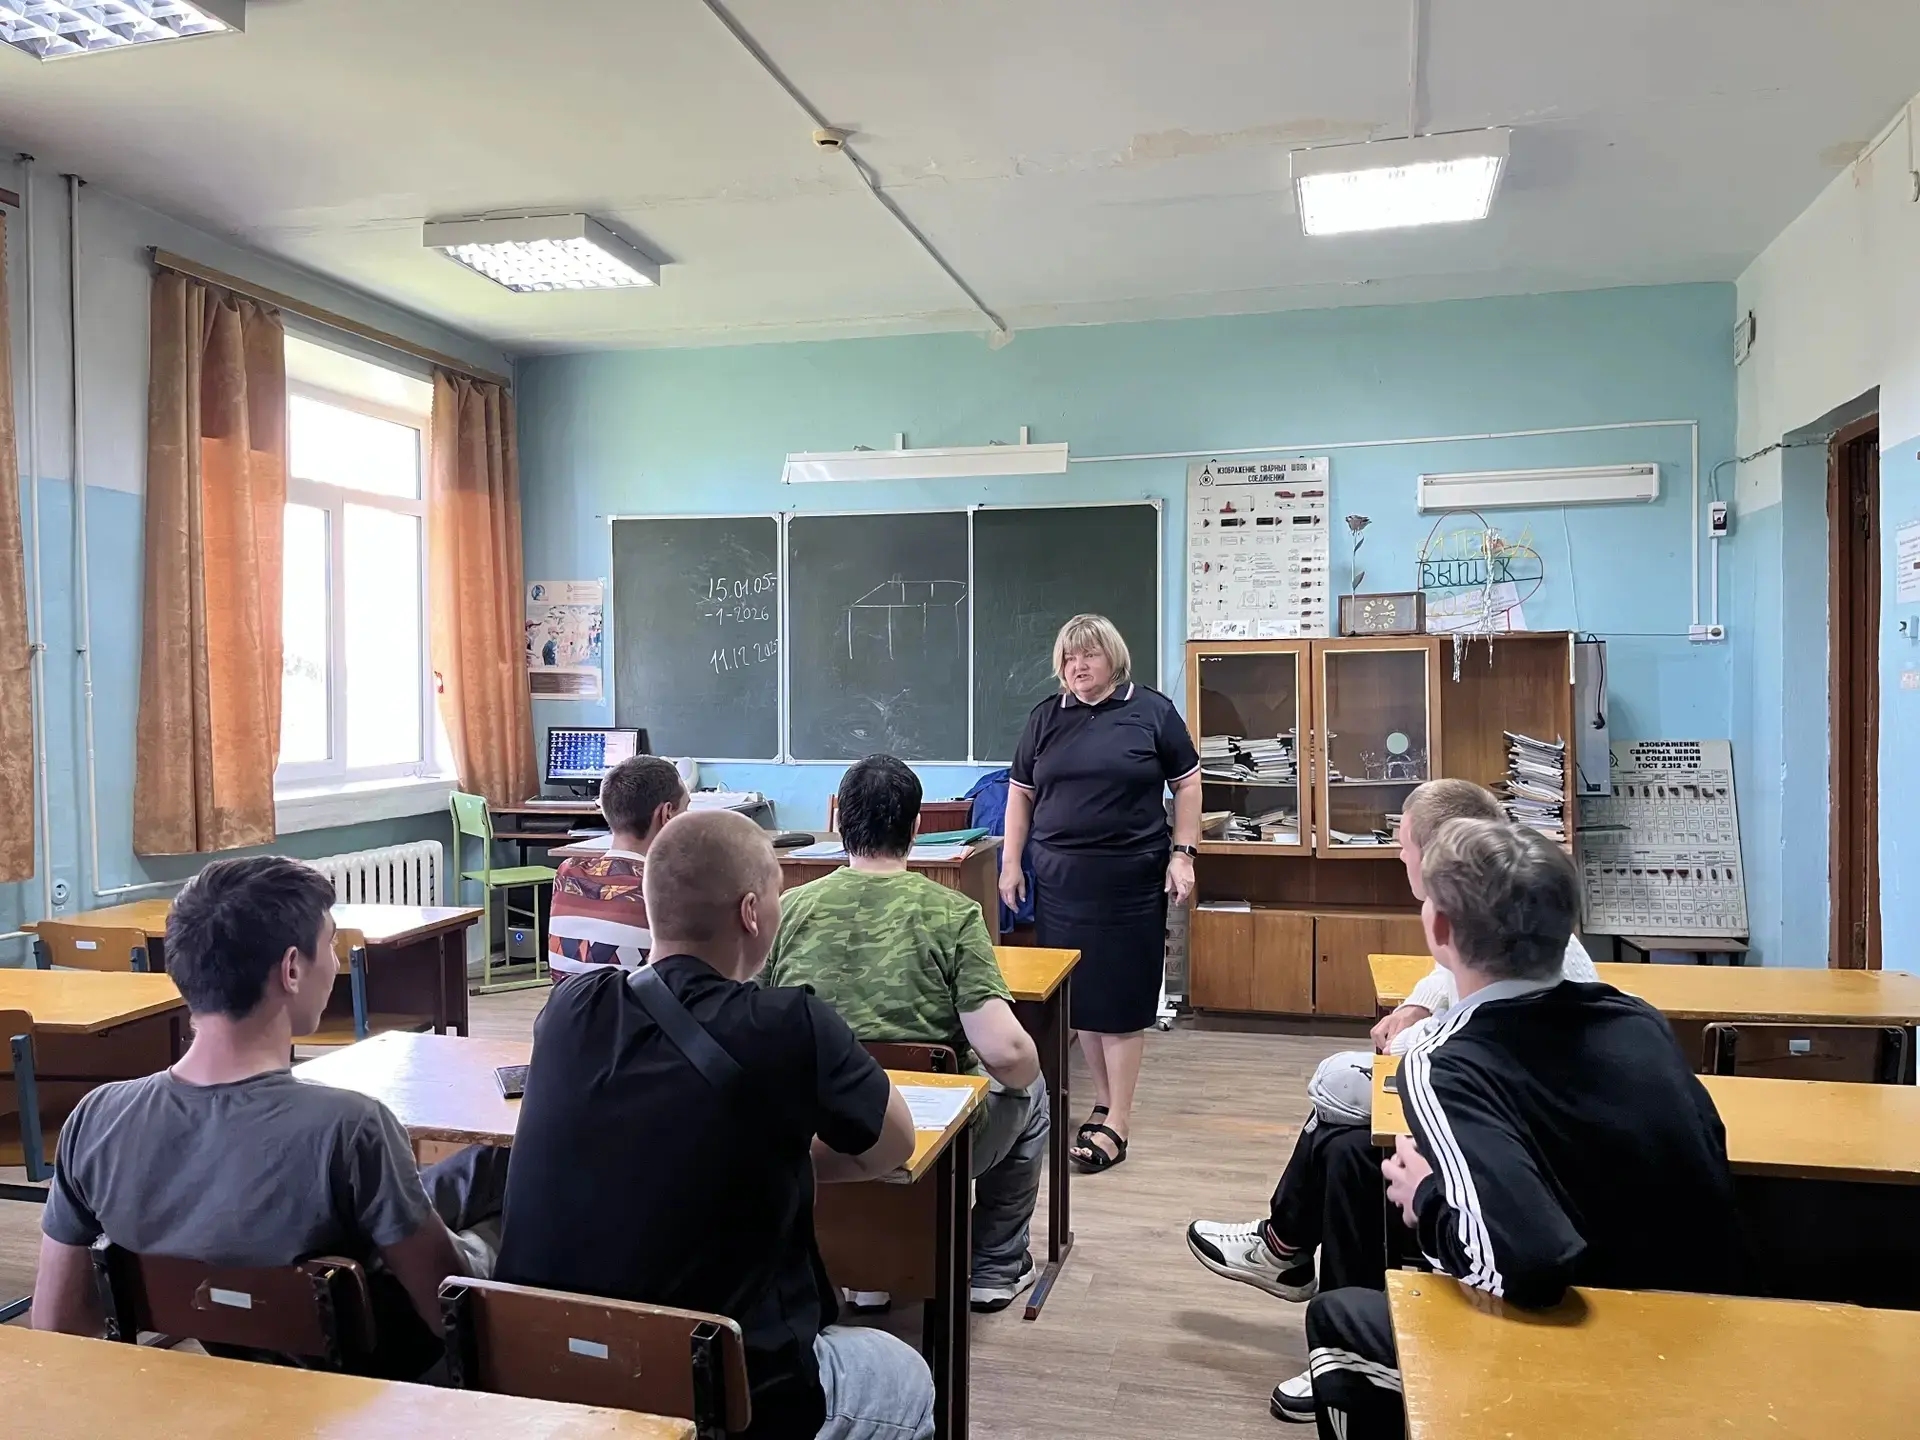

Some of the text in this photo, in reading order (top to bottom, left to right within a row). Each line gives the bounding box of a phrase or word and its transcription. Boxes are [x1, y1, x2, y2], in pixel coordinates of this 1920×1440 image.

[1217, 465, 1256, 474] ИЗОБРАЖЕНИЕ
[1260, 464, 1286, 472] СВАРНЫХ
[1290, 463, 1307, 471] ШВОВ
[1247, 473, 1285, 482] СОЕДИНЕНИЙ
